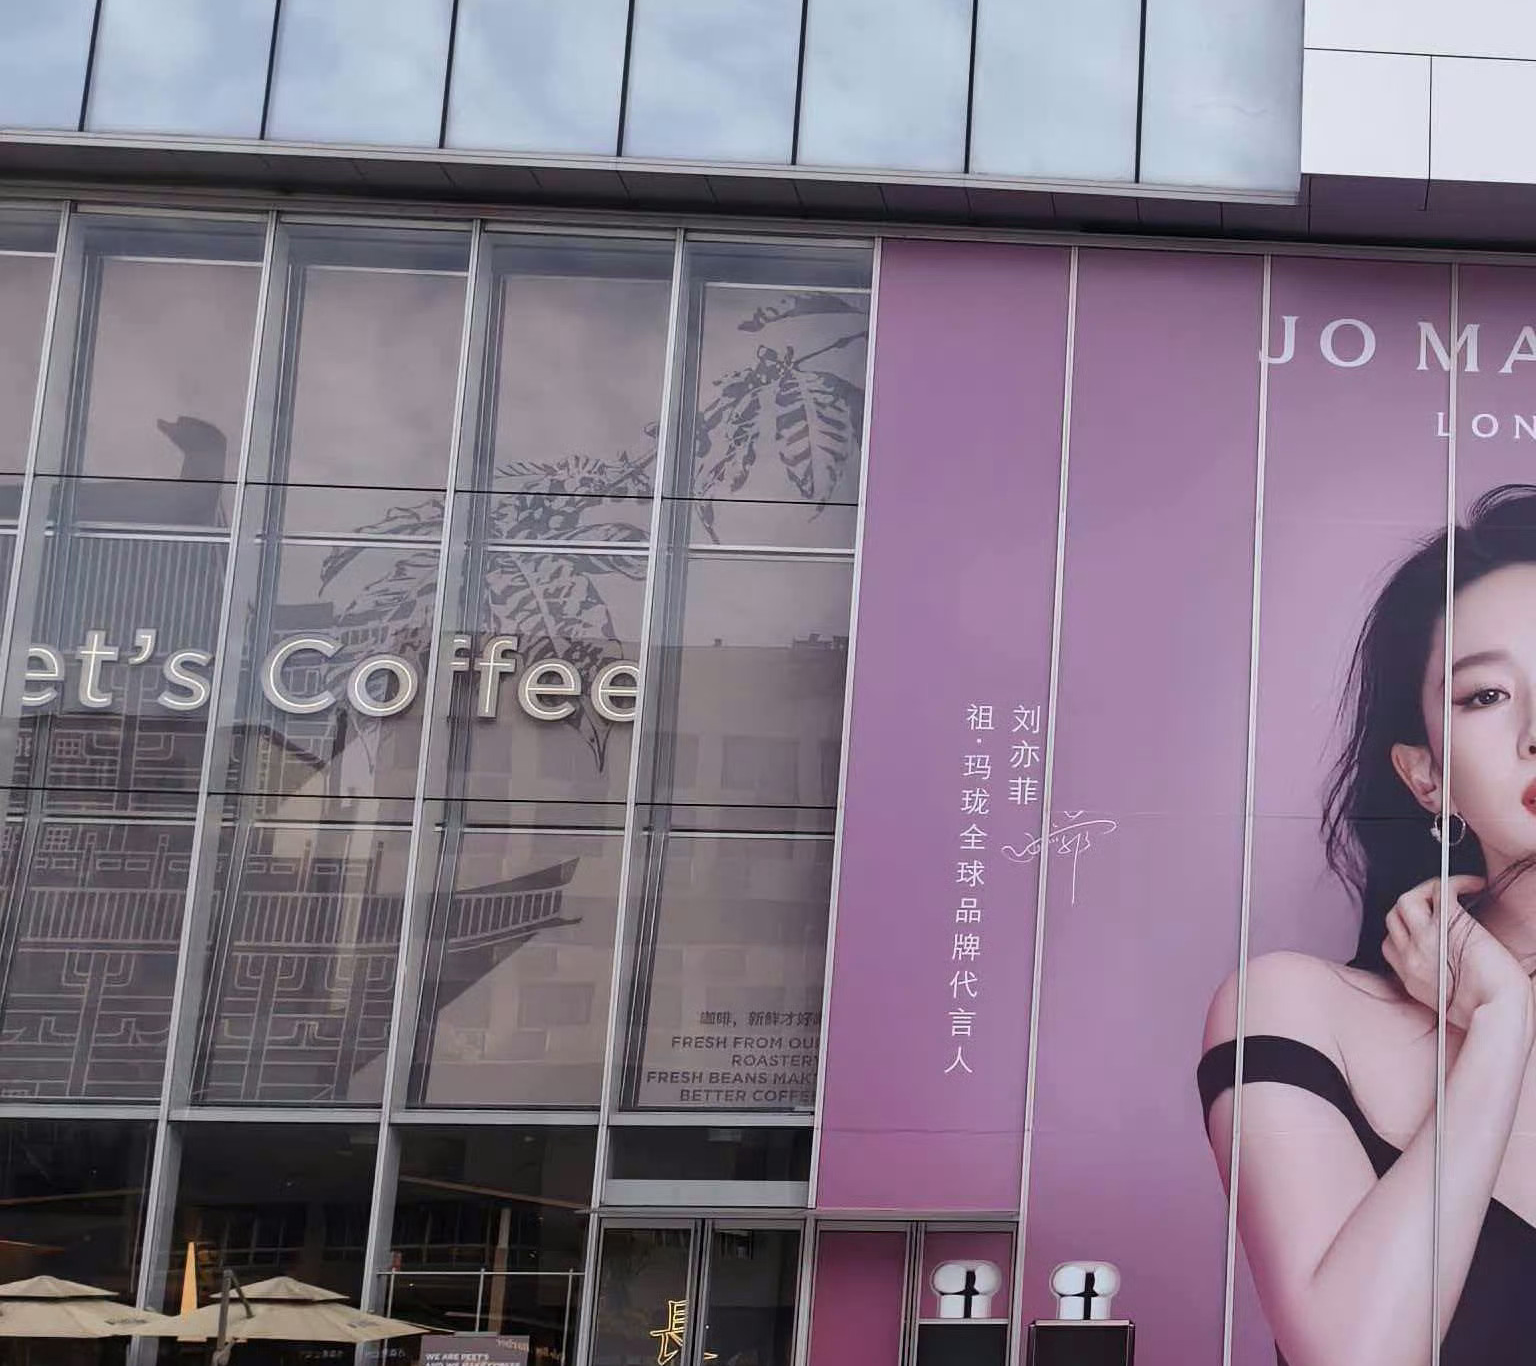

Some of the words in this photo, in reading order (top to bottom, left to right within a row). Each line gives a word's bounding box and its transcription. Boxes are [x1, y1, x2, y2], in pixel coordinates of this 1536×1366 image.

[1258, 315, 1377, 367] JO
[1007, 704, 1042, 806] 刘亦菲
[944, 703, 995, 1075] 祖·玛珑全球品牌代言人
[671, 1036, 728, 1050] FRESH
[732, 1036, 783, 1050] FROM
[647, 1070, 703, 1085] FRESH
[708, 1071, 768, 1085] BEANS
[680, 1089, 747, 1103] BETTER
